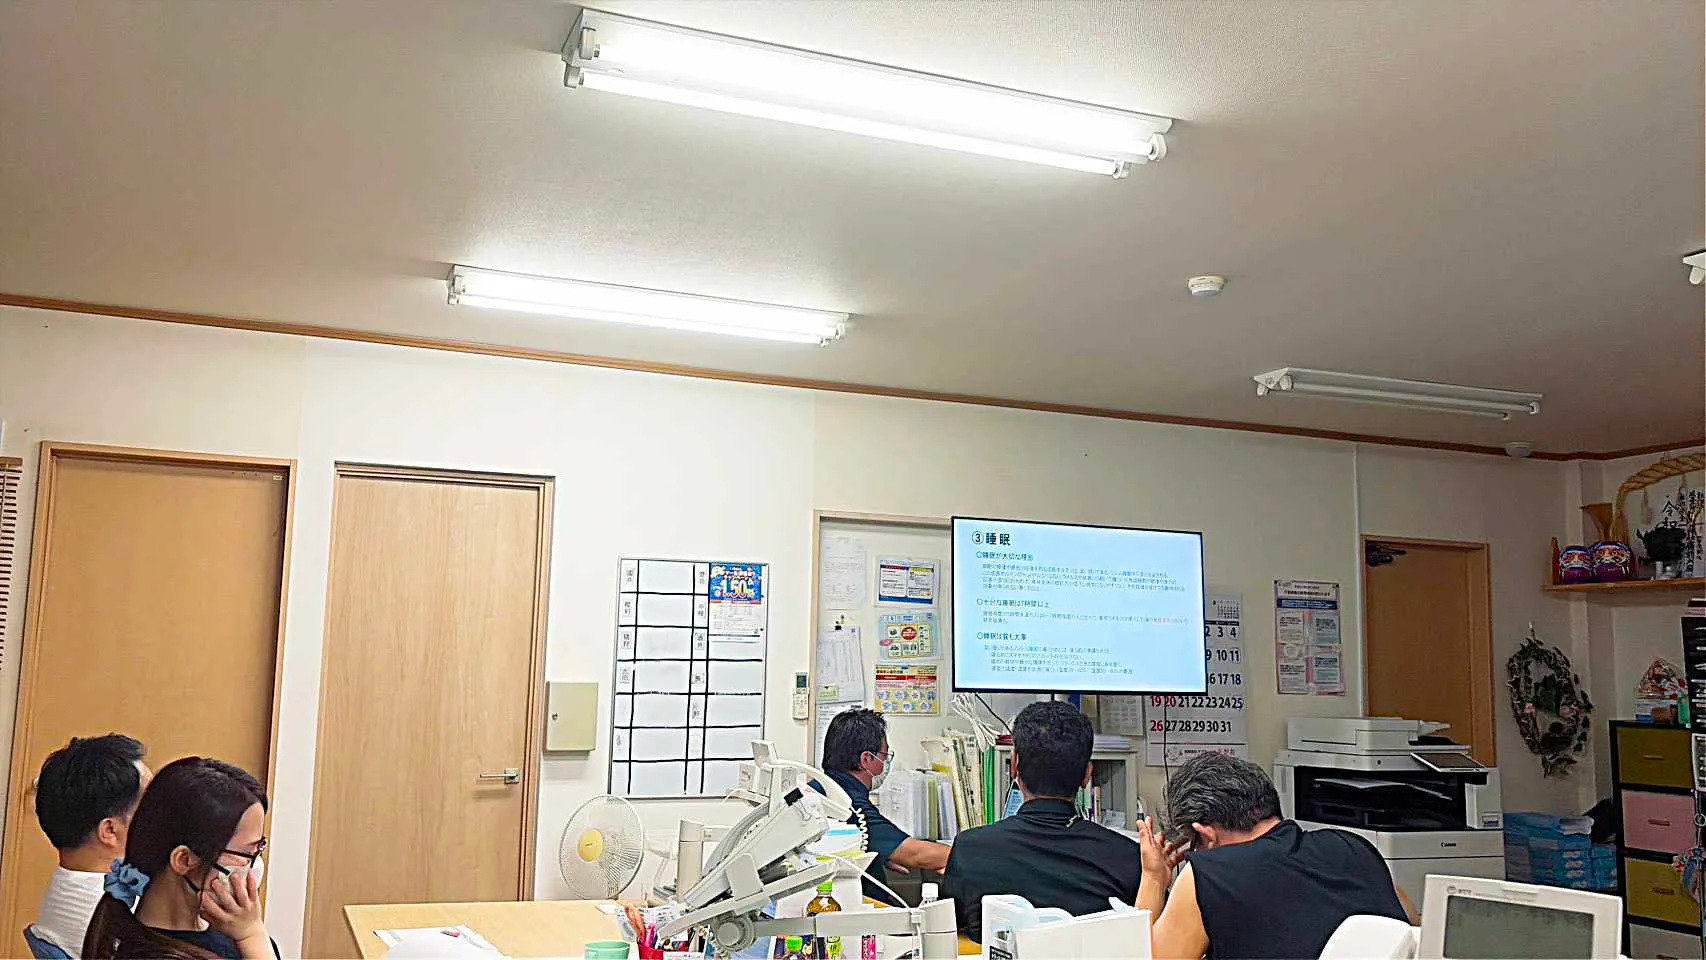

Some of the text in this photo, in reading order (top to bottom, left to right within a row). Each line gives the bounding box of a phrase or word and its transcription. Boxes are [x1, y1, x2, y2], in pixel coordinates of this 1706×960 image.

[1218, 626, 1223, 637] 3
[1230, 627, 1236, 638] 4
[1216, 650, 1227, 661] 10
[1229, 650, 1239, 661] 11
[1218, 673, 1228, 685] 17
[1230, 674, 1241, 685] 18
[1151, 696, 1243, 709] 19 20 21 22 23 24 25
[1150, 720, 1231, 732] 26 27 28 29 30 31
